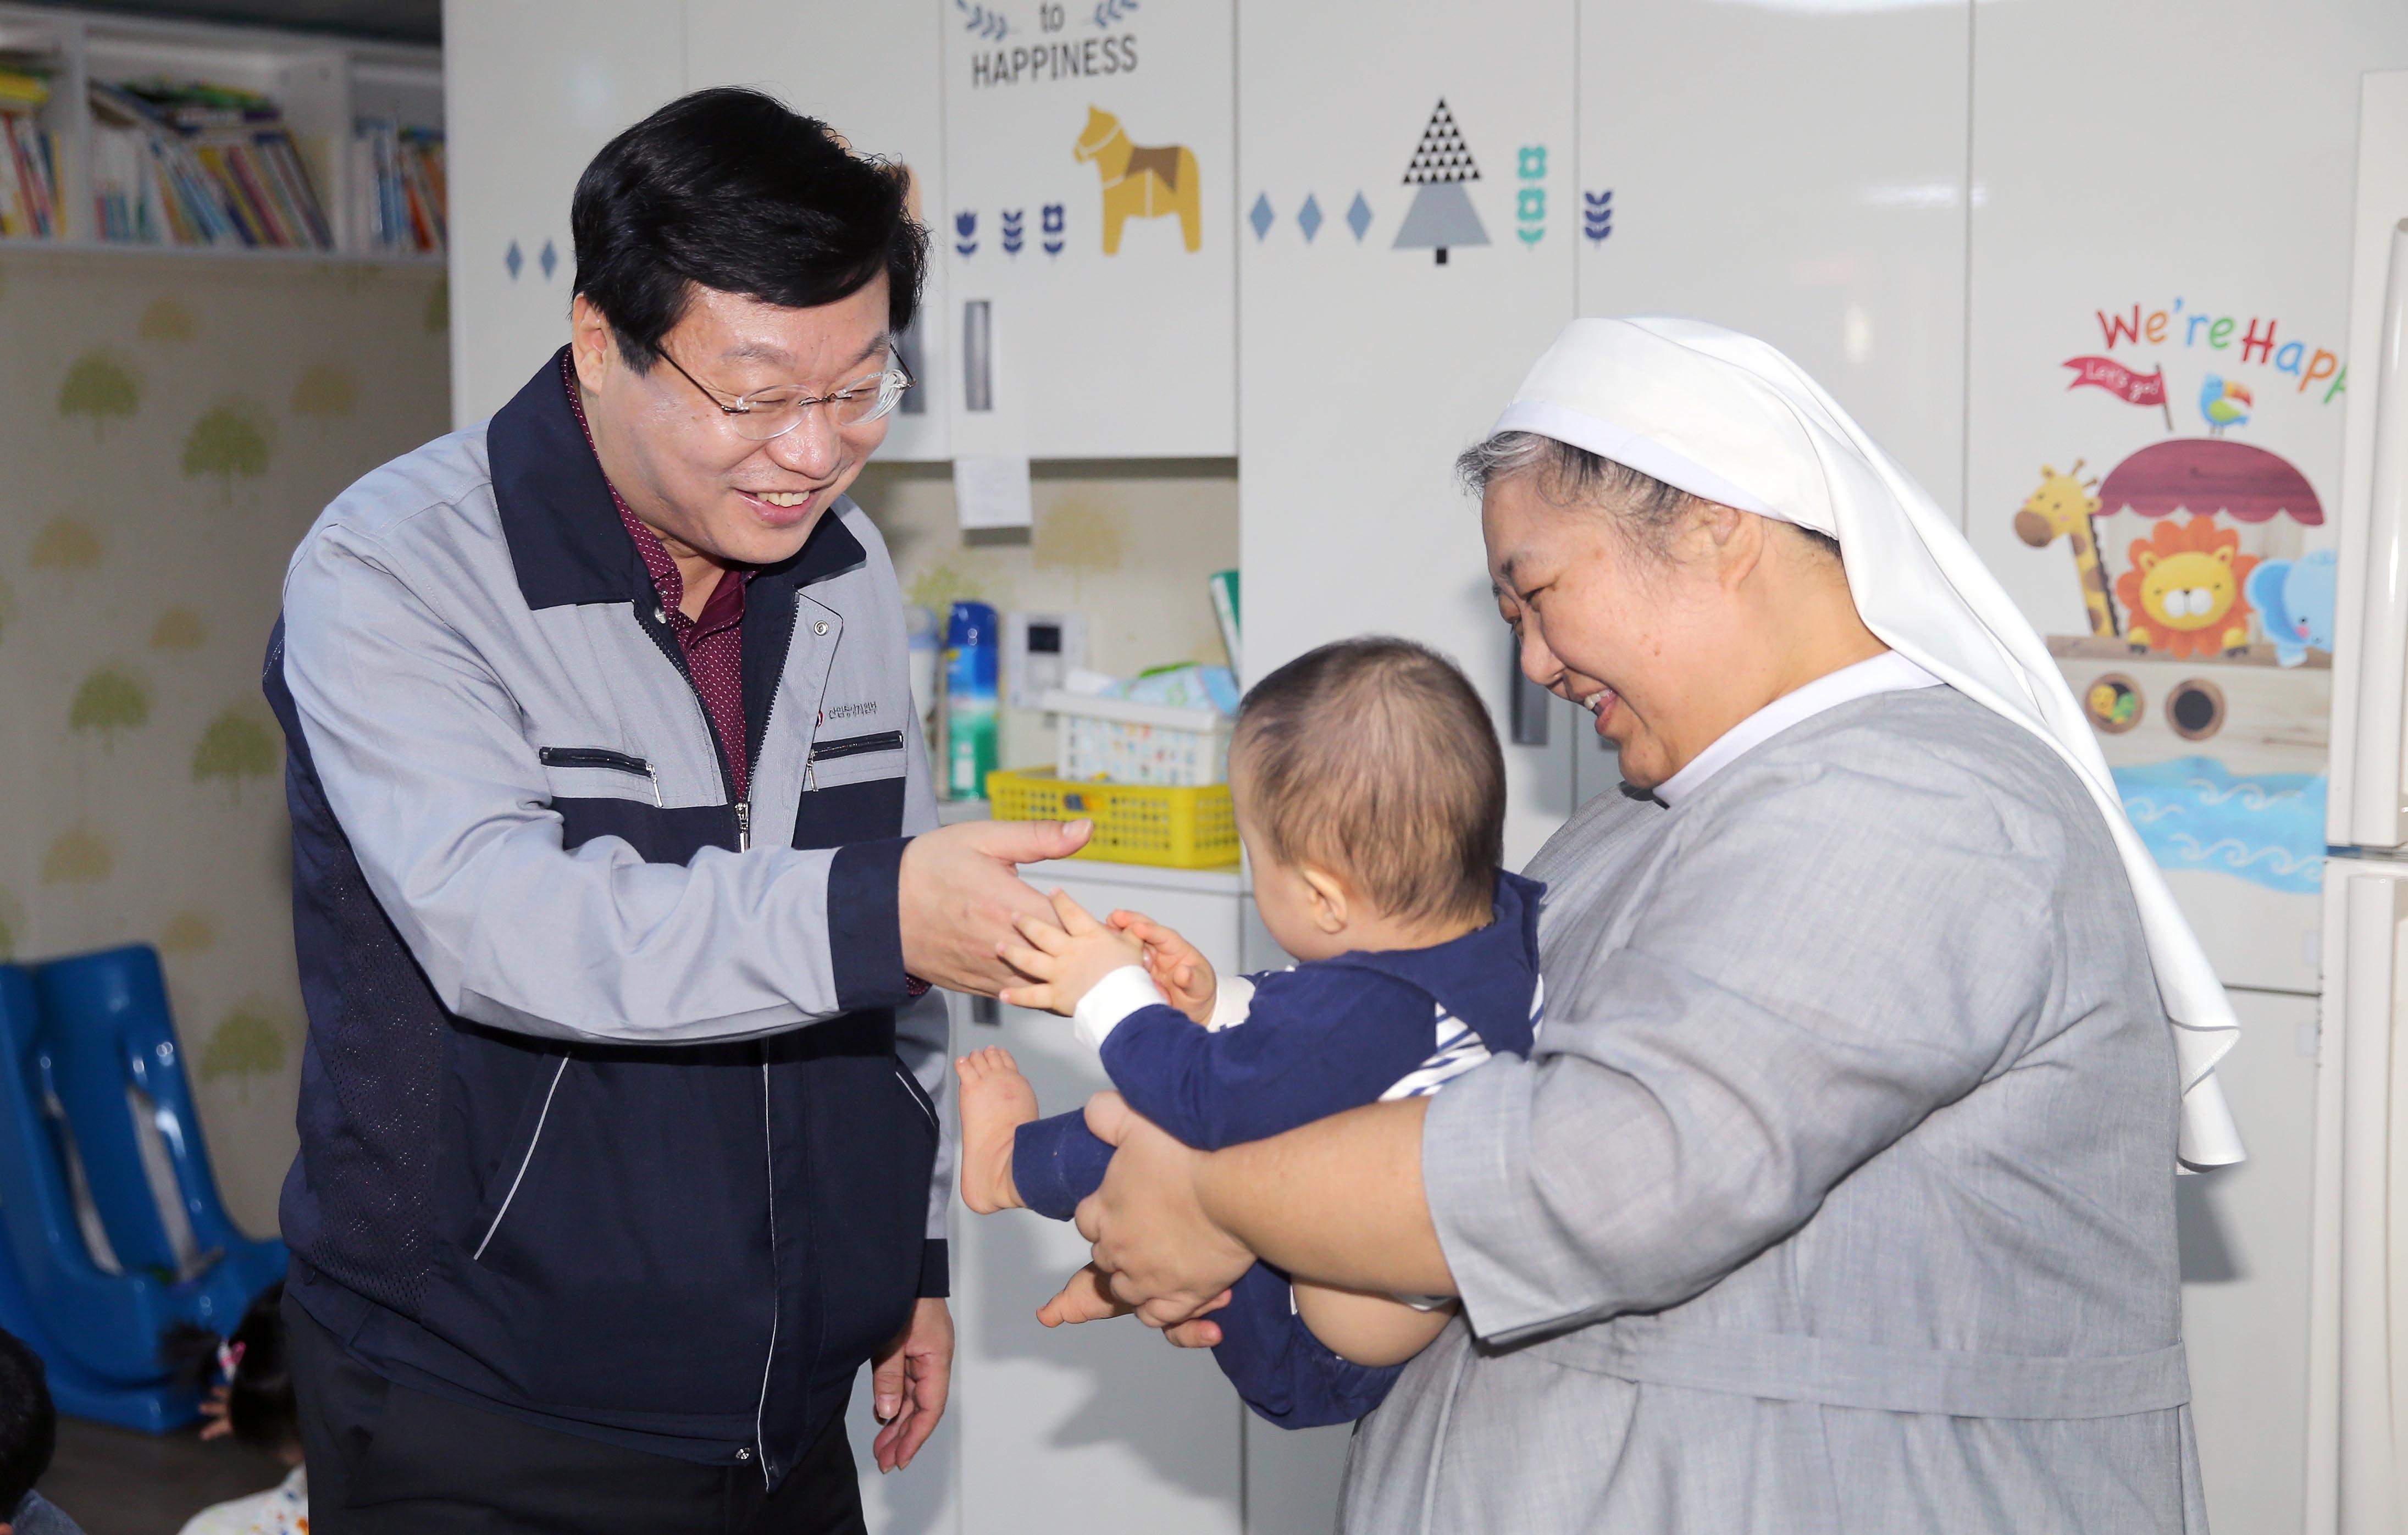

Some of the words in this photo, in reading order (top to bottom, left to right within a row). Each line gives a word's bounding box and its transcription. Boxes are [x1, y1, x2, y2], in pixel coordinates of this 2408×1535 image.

[1040, 1, 1065, 32] to
[971, 34, 1138, 88] HAPPINESS
[2095, 297, 2236, 350] We're
